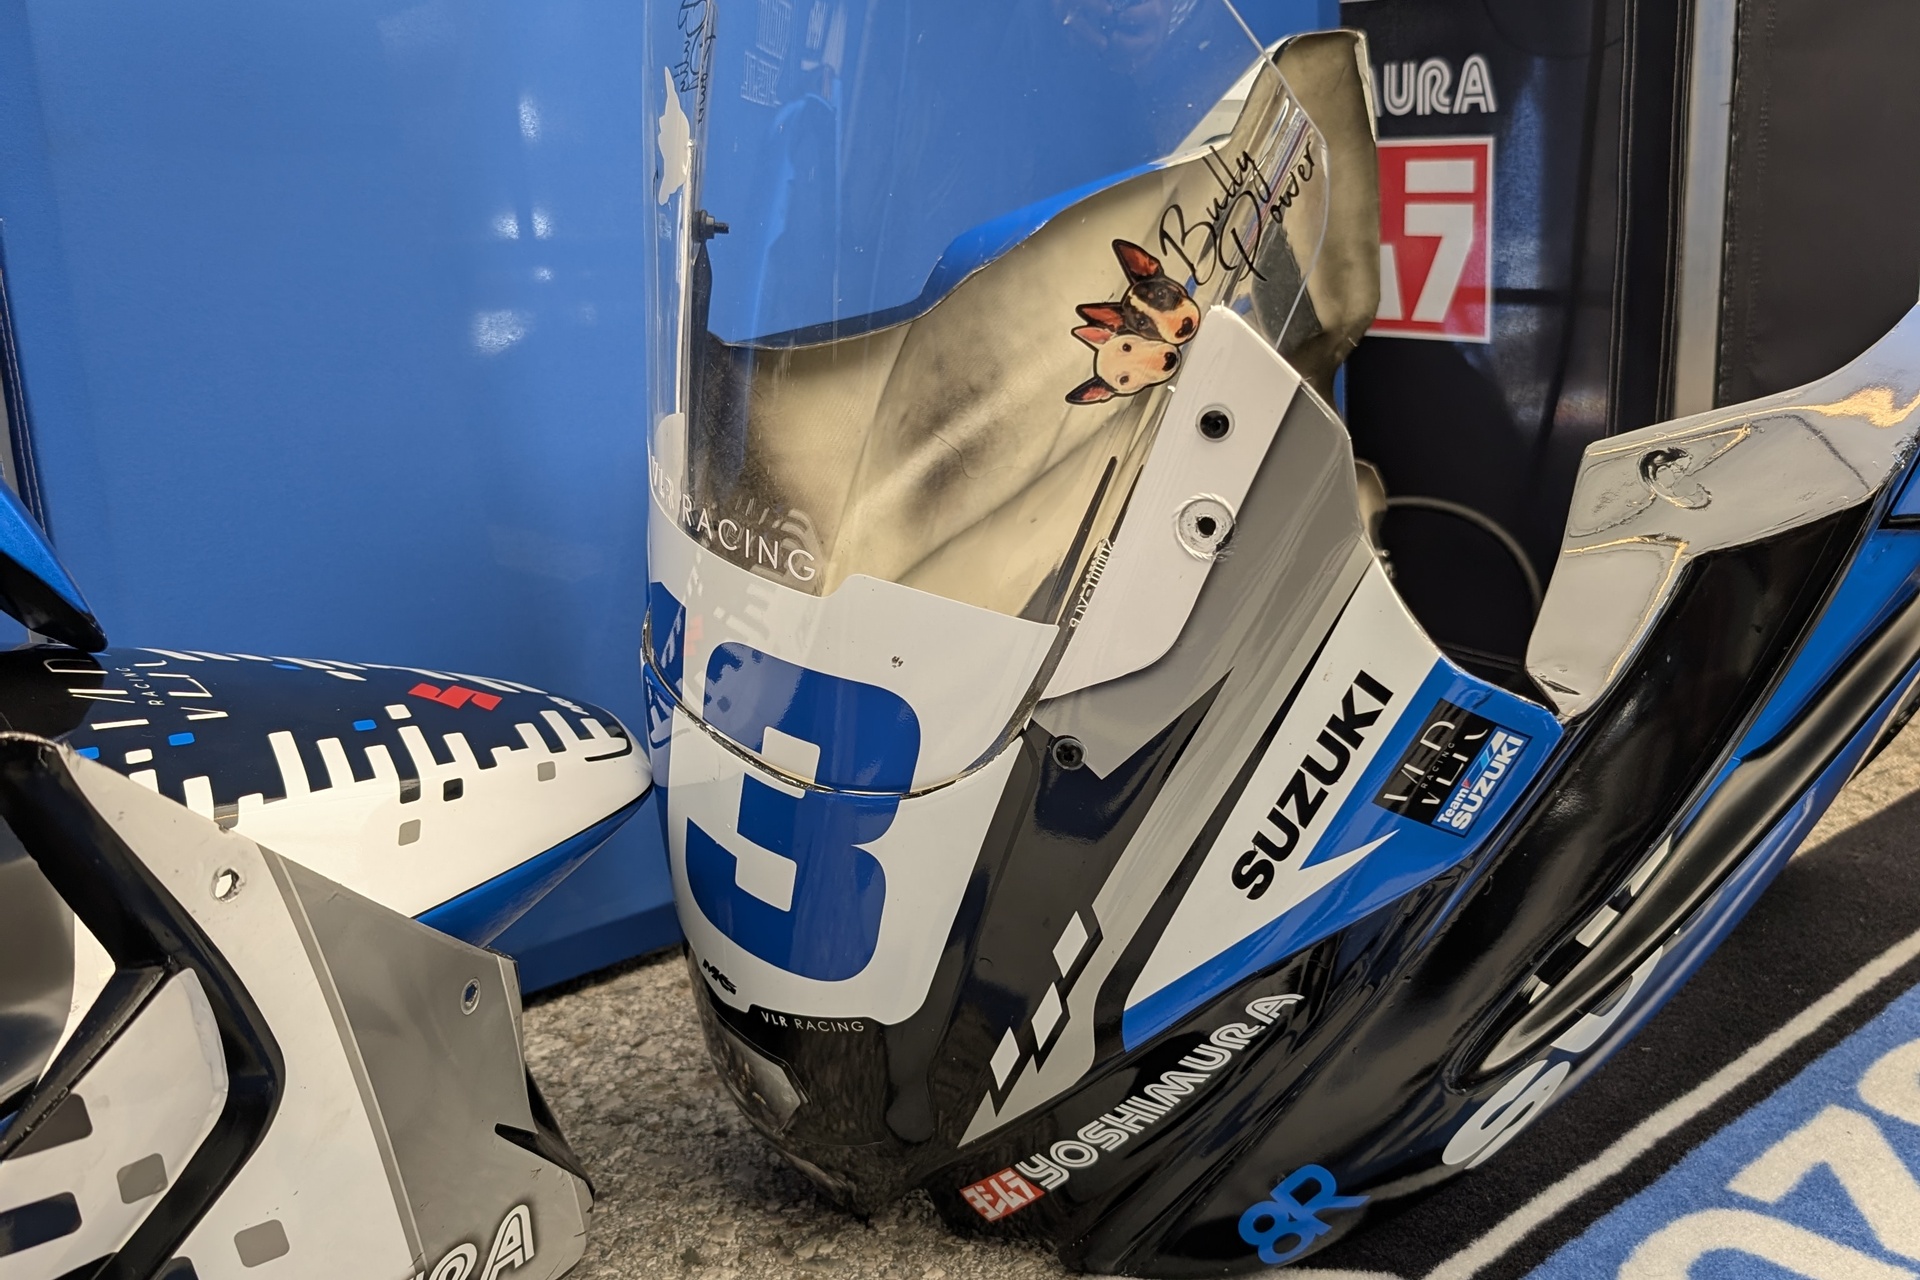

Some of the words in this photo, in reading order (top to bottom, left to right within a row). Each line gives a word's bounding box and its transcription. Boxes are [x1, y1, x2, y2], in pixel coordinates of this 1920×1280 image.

[1370, 55, 1496, 116] URA
[1158, 145, 1272, 286] Bully
[1217, 140, 1315, 282] Power
[682, 493, 816, 582] RACING
[115, 667, 166, 706] RACING
[685, 641, 920, 983] 3
[1231, 669, 1395, 900] SUZUKI
[1421, 742, 1456, 789] RACING
[1437, 787, 1469, 824] Team
[1451, 735, 1524, 830] SUZUKI
[760, 1010, 789, 1028] VLR
[794, 1017, 865, 1033] RACING
[1015, 993, 1305, 1190] YOSHIMURA
[1238, 1164, 1371, 1265] 8R
